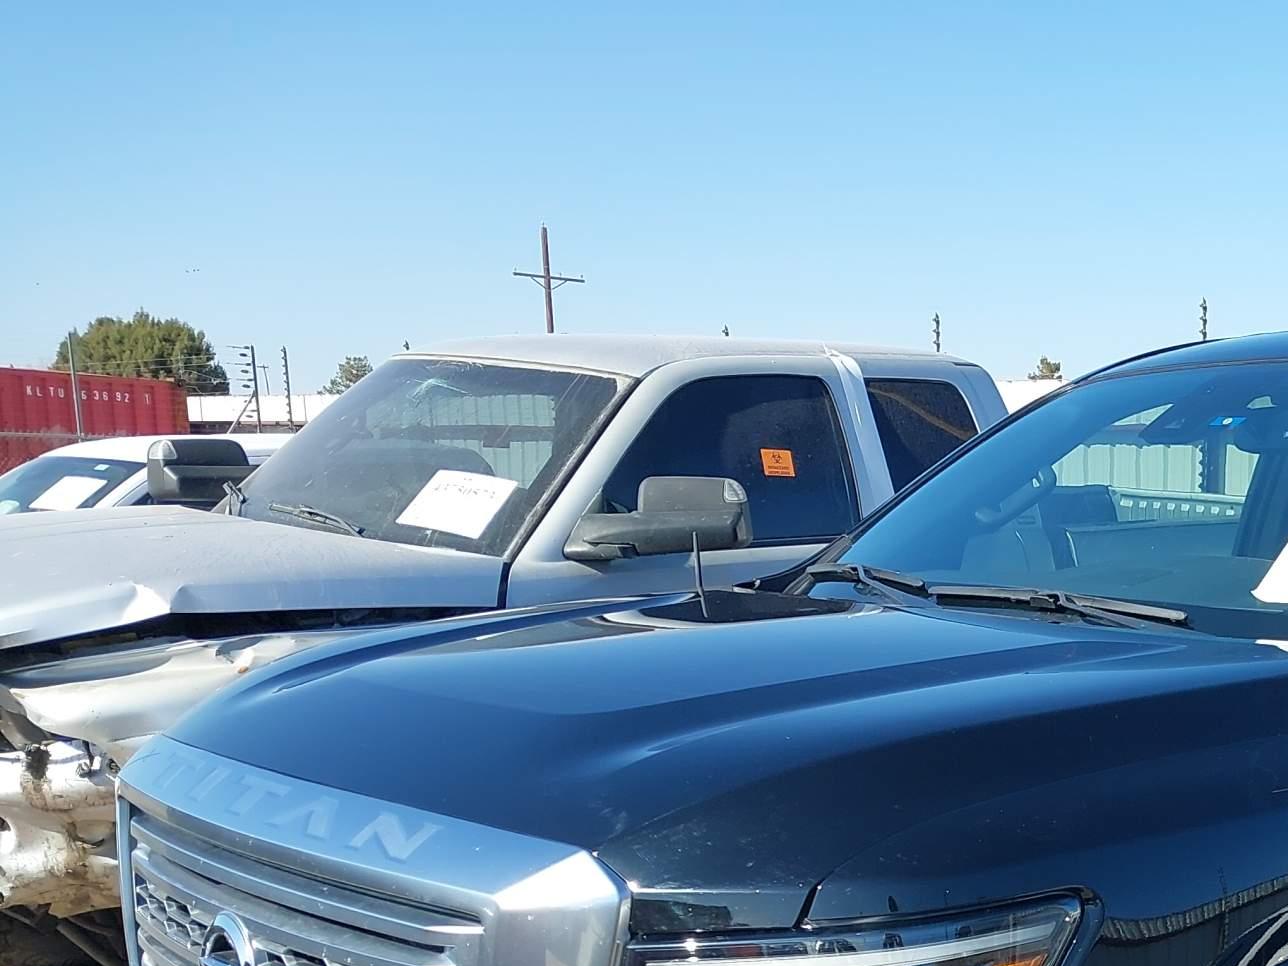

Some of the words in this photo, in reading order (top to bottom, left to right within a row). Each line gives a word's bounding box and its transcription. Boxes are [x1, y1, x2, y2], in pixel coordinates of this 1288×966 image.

[26, 385, 65, 399] KLTU
[80, 390, 130, 403] 63692
[154, 751, 444, 864] TITAN
